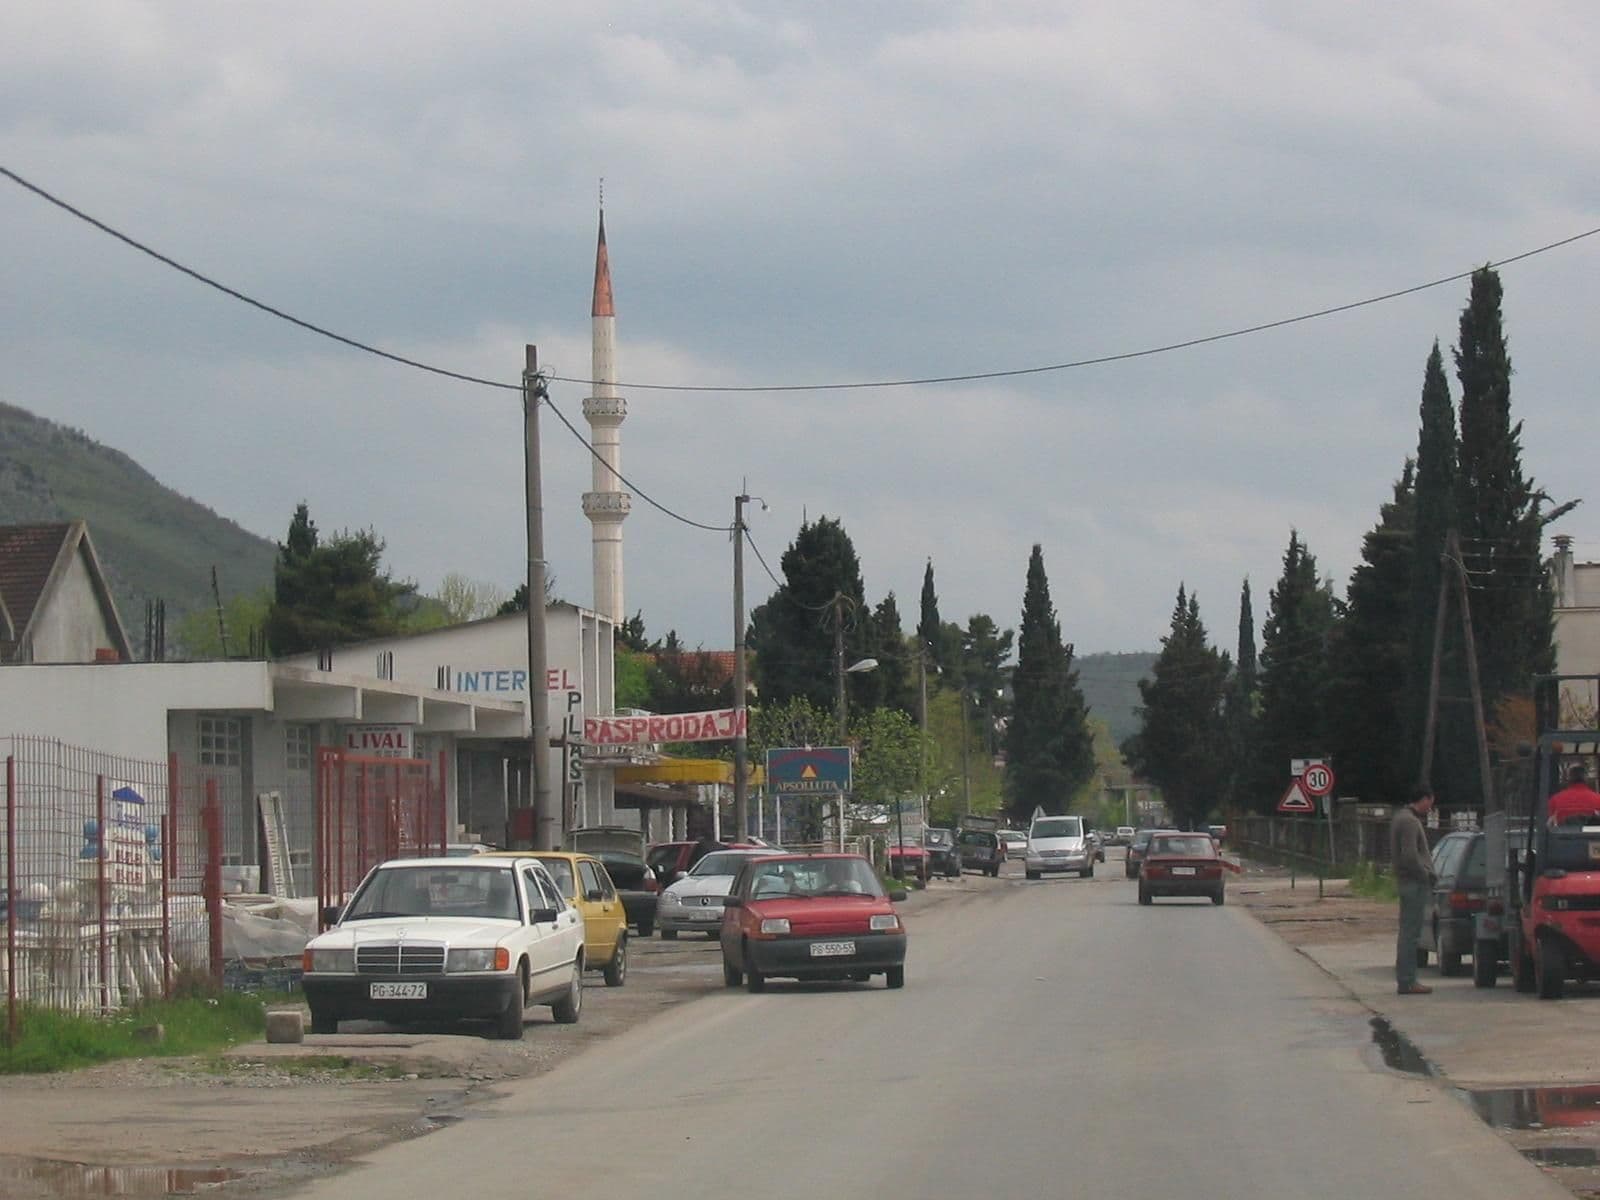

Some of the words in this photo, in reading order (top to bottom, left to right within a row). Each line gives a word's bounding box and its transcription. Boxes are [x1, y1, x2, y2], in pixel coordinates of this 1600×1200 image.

[457, 670, 527, 692] INTER
[348, 733, 408, 749] LIVAL
[1309, 771, 1327, 788] 30
